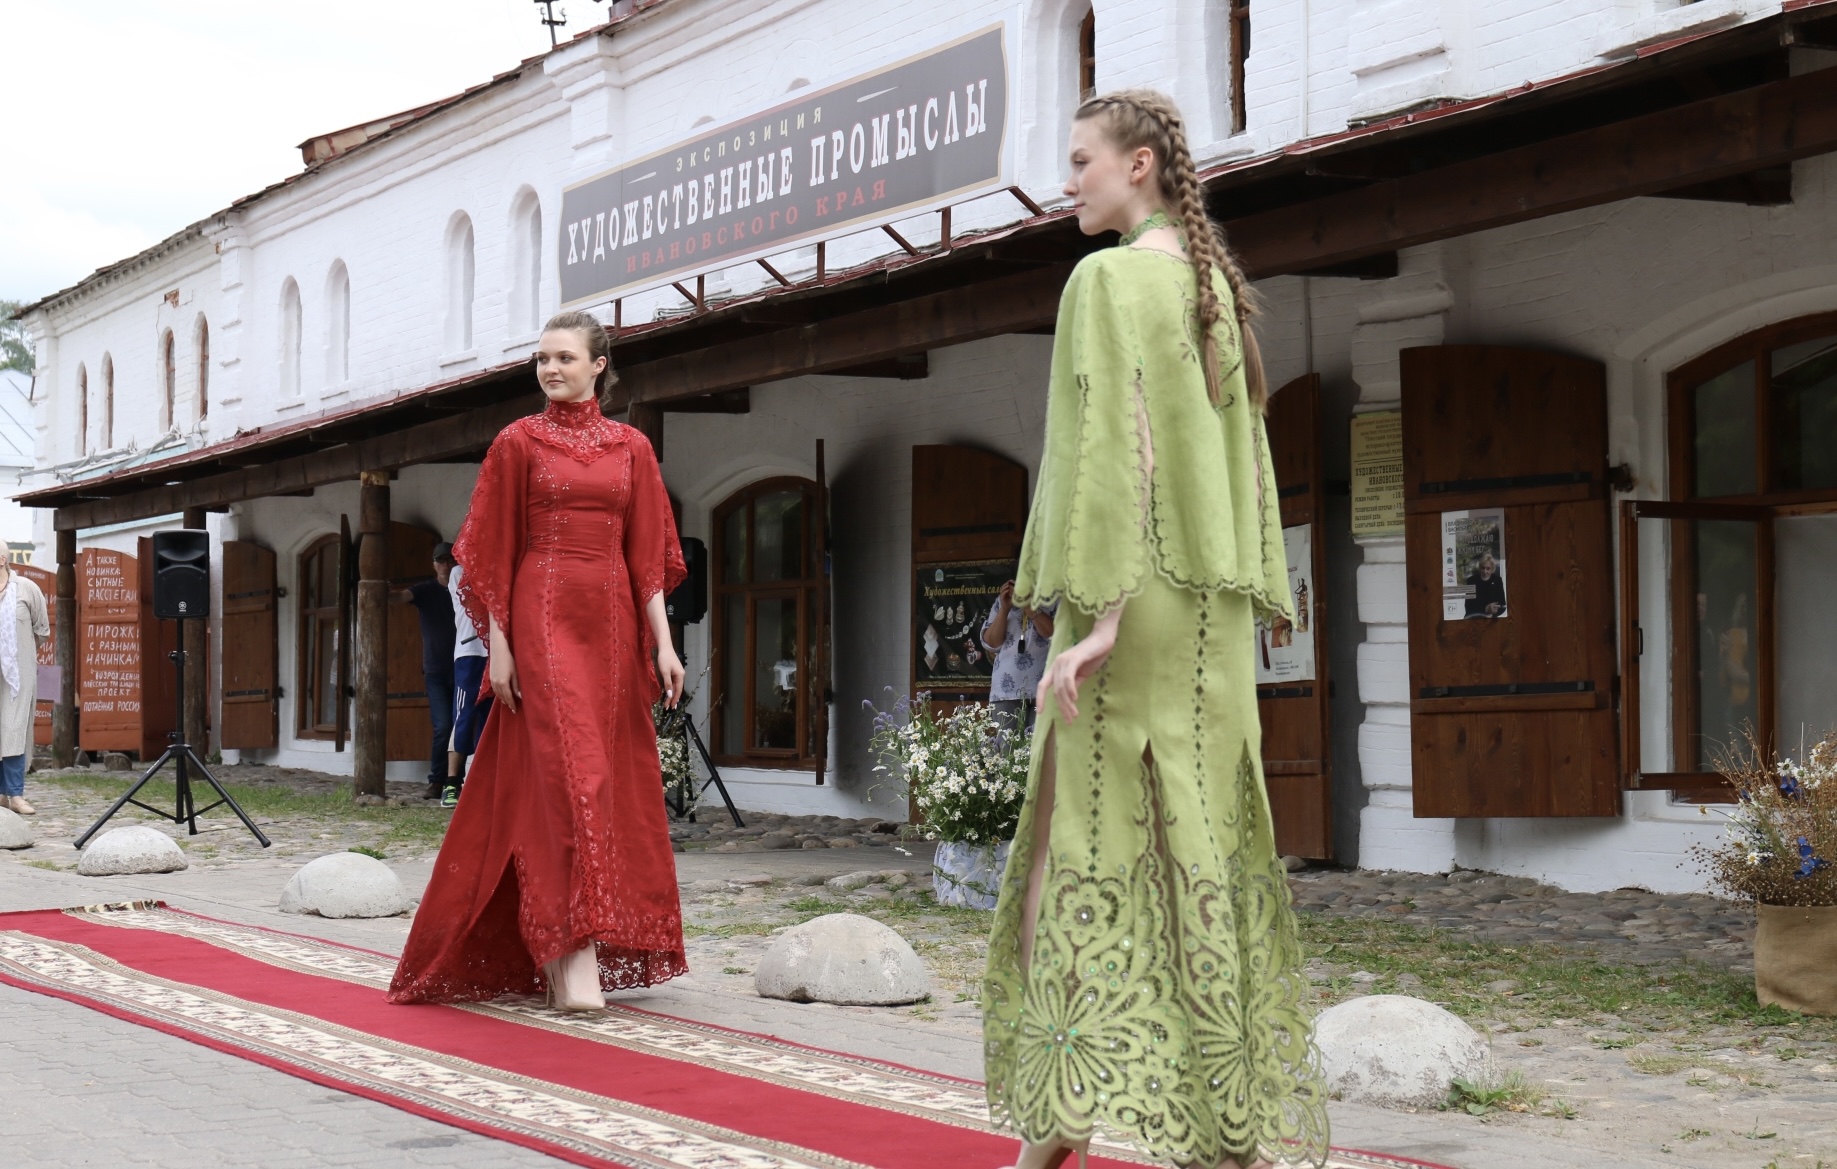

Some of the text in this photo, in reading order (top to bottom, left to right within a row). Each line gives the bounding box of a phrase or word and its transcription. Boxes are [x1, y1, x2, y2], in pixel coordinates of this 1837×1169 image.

[676, 106, 822, 172] ЭКСПОЗИЦИЯ
[567, 78, 988, 266] ХУДОЖЕСТВЕННЫЕ ПРОМЫСЛЫ
[626, 178, 887, 273] ИВАНОВСКОГО КРАЯ
[85, 553, 117, 566] А ТАКЖЕ
[87, 577, 125, 587] СЫТНЫЕ
[924, 584, 986, 599] Художественный
[89, 641, 95, 651] С
[97, 687, 131, 696] ПРОЕКТ
